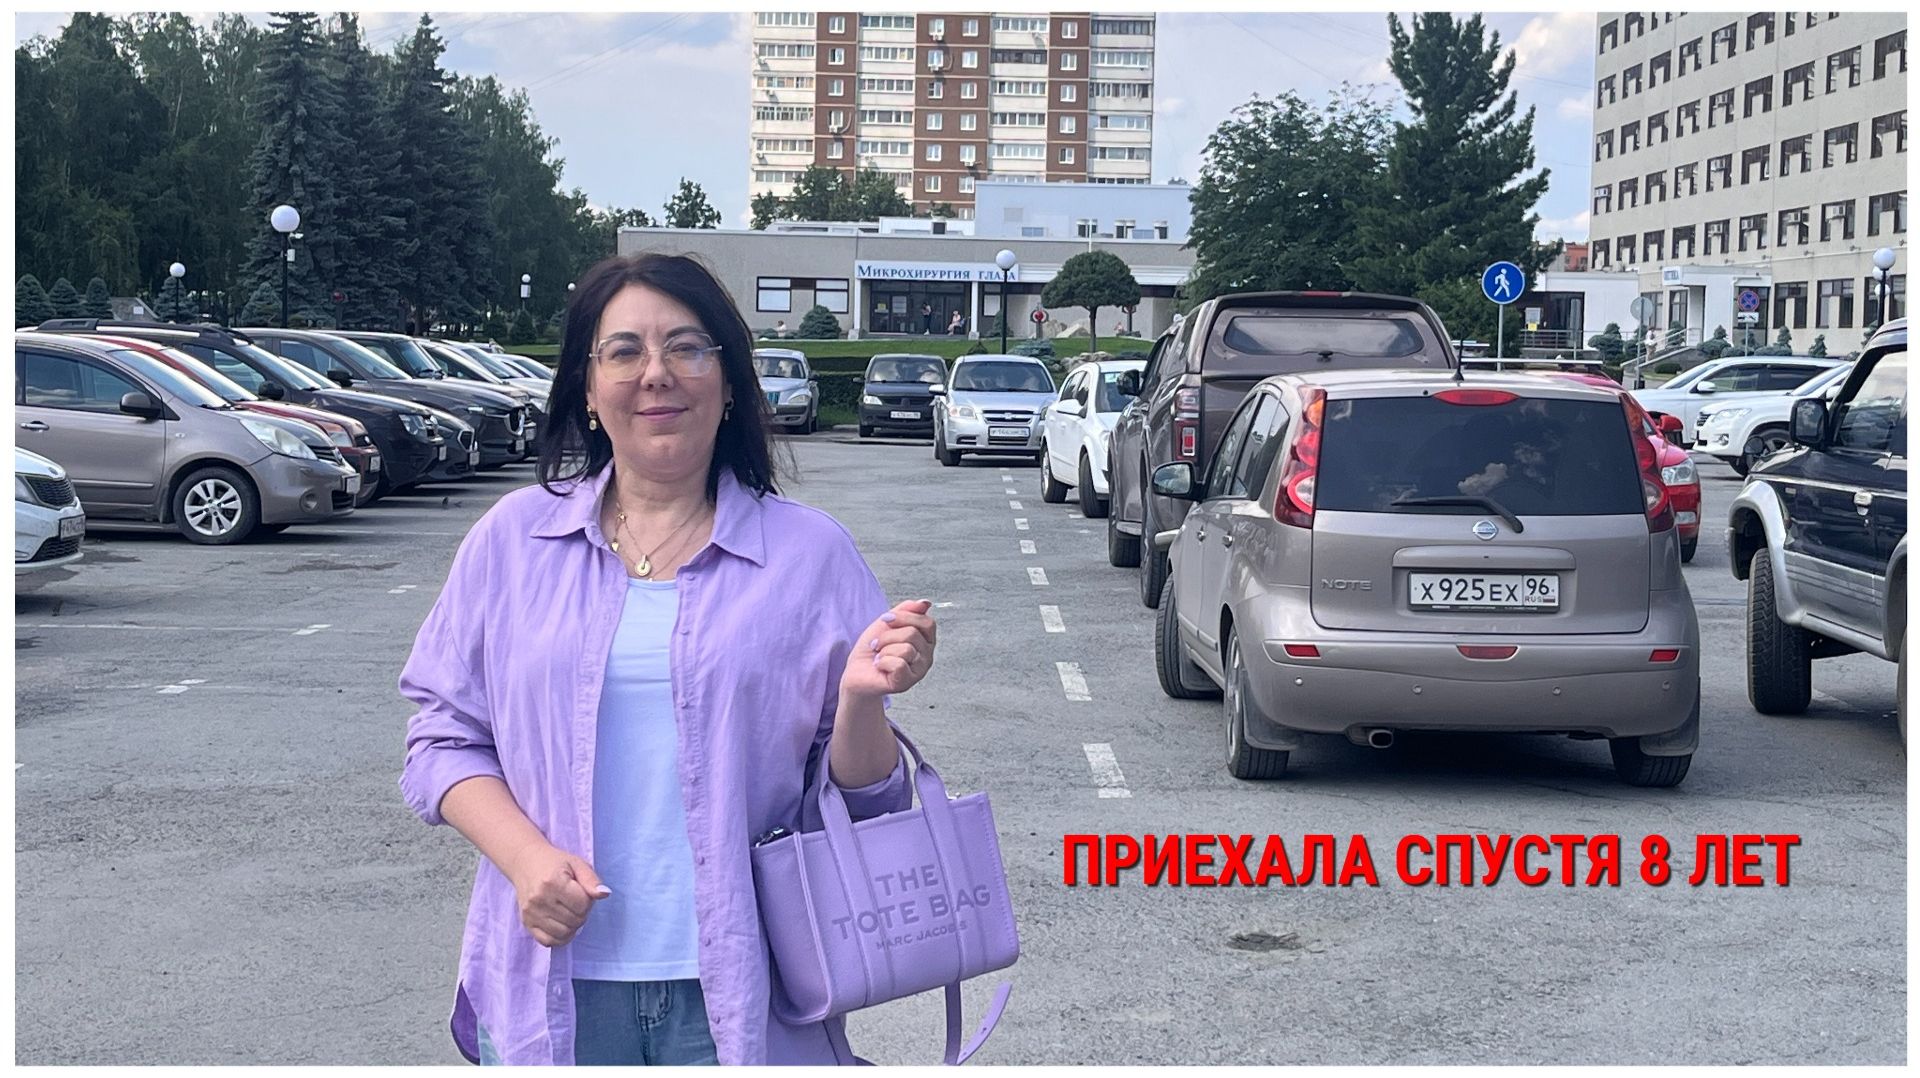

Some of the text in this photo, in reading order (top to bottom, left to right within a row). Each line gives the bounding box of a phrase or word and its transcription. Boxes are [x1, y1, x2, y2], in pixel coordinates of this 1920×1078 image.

[1320, 578, 1373, 591] NOTE
[1526, 578, 1549, 596] 96
[1524, 596, 1543, 604] RUS
[875, 864, 938, 896] THE
[831, 884, 991, 940] TOTE BAG
[876, 933, 914, 950] MARC
